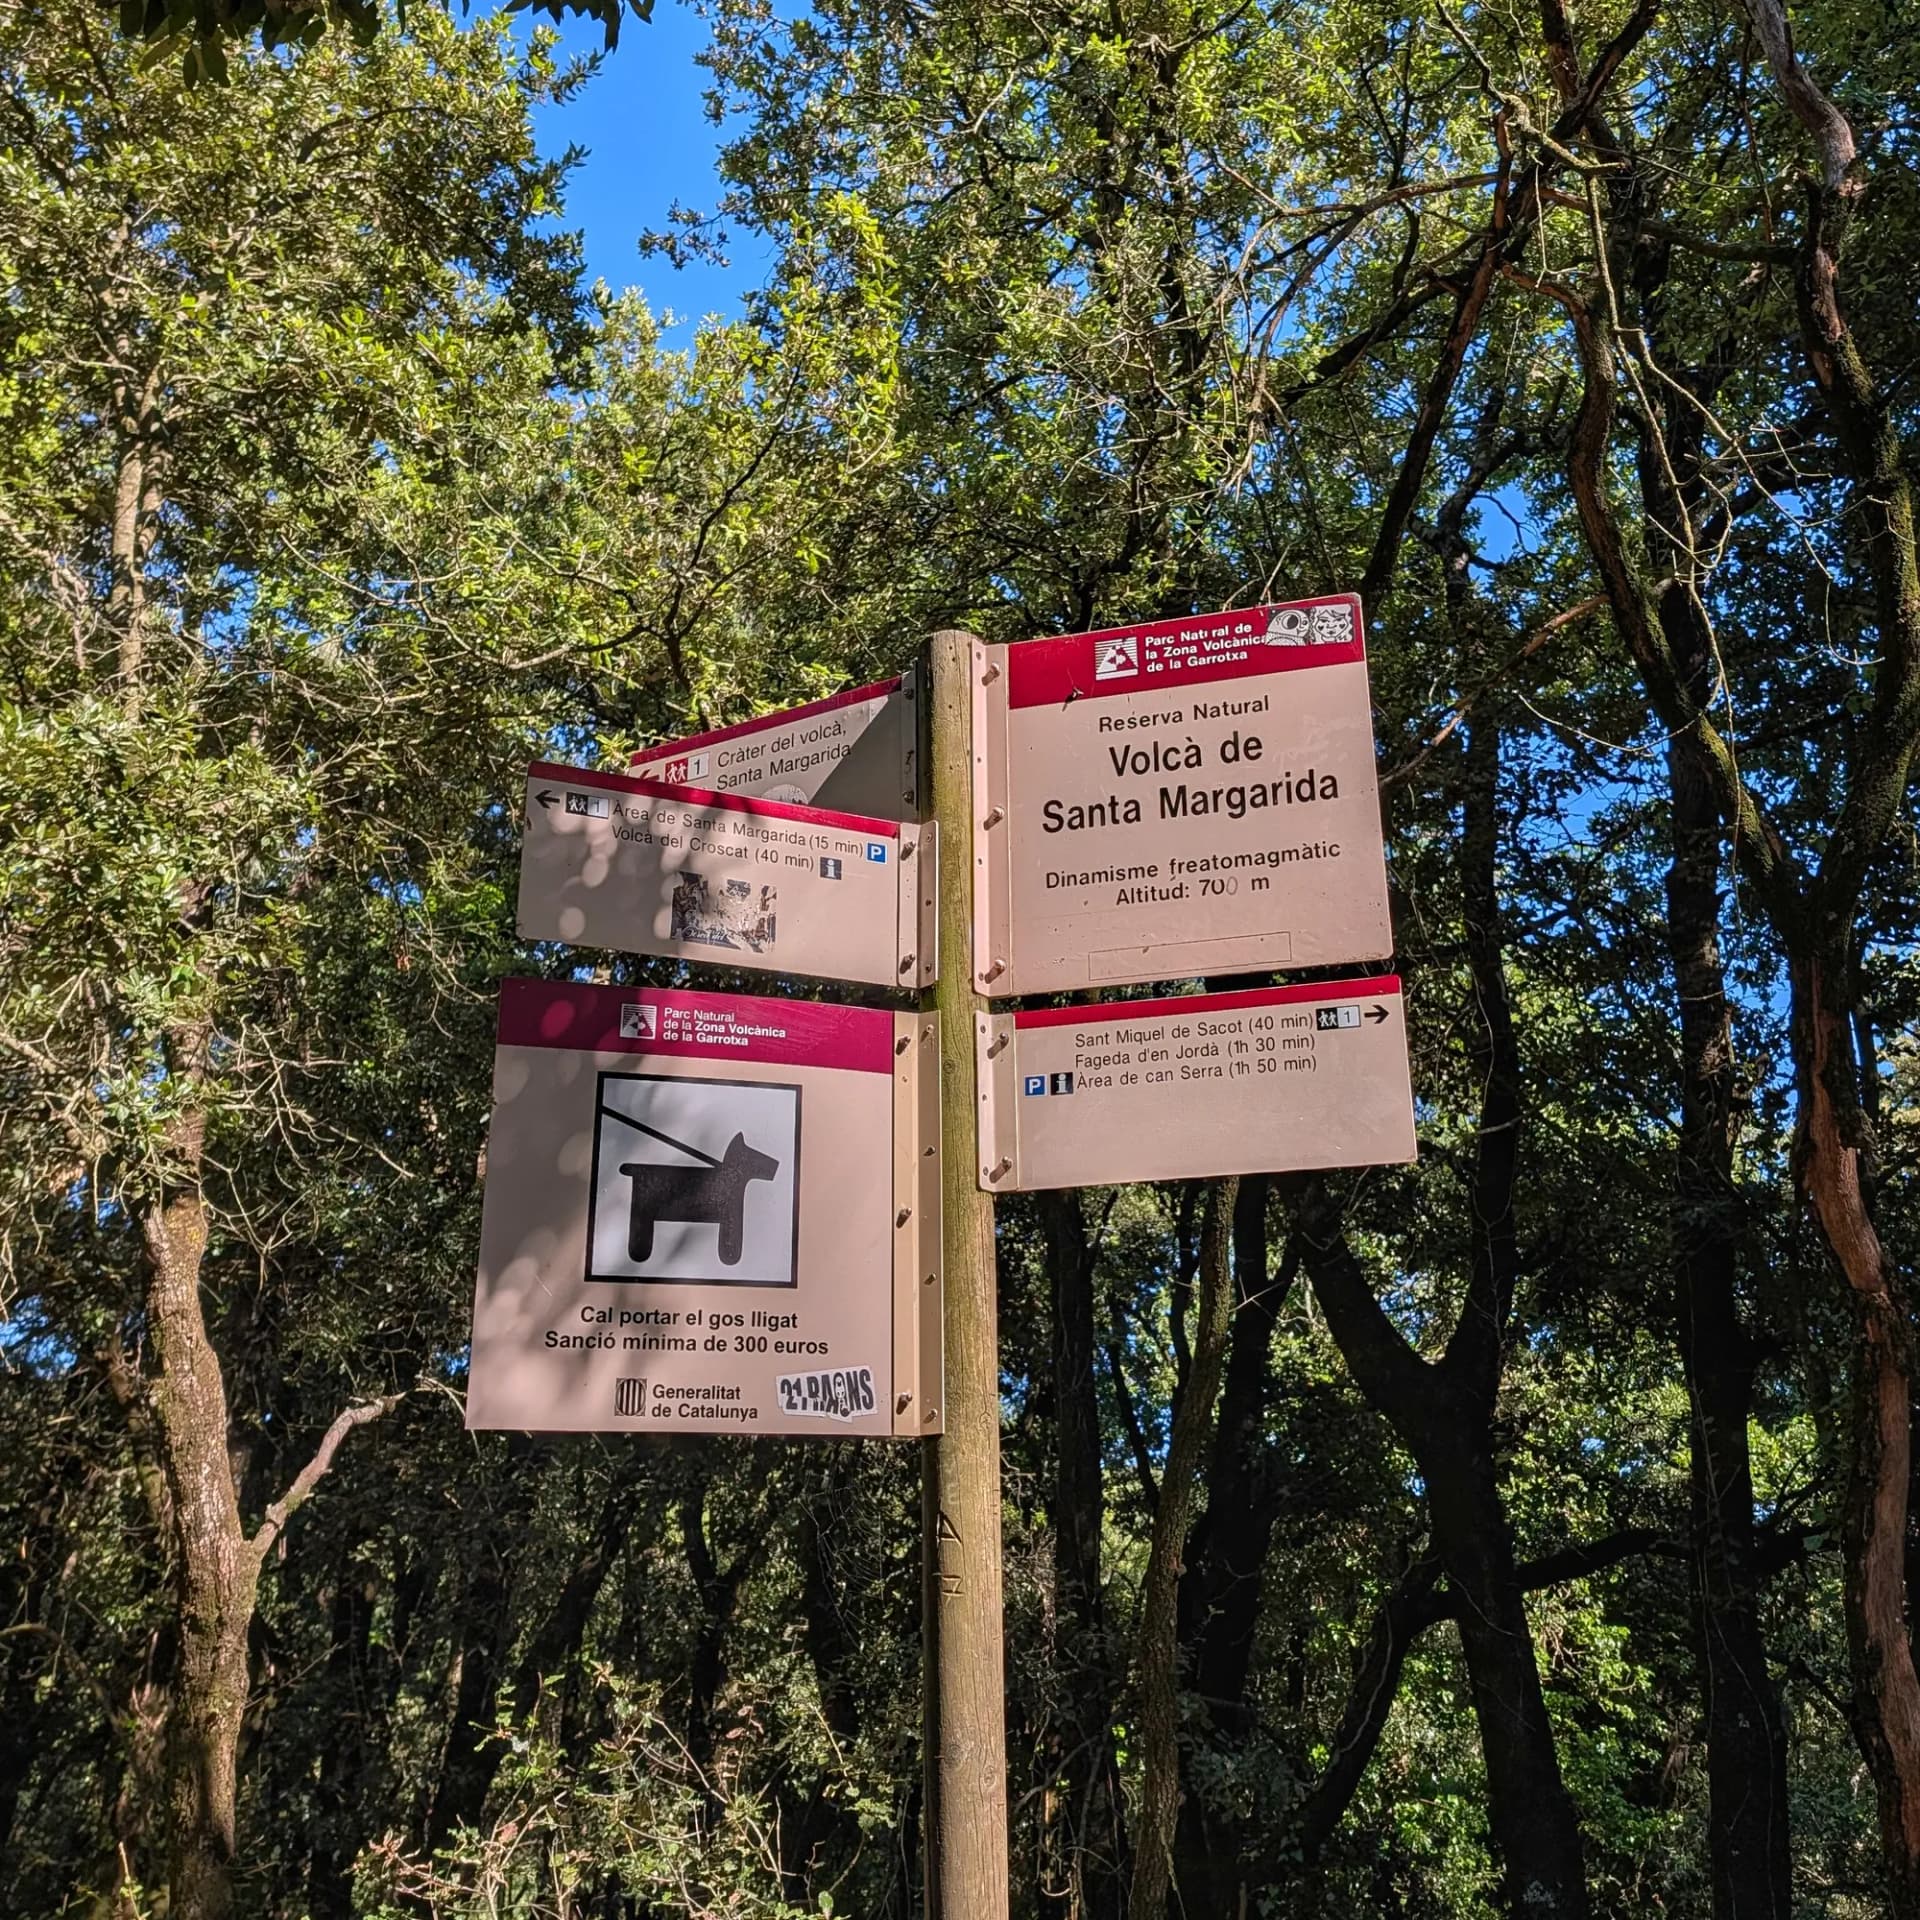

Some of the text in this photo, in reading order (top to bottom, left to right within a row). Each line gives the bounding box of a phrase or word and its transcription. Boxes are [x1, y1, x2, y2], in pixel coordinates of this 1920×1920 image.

[1145, 634, 1174, 647] Parc
[1234, 623, 1252, 634] de
[1146, 649, 1157, 660] la
[1163, 644, 1197, 658] Zona
[1147, 650, 1248, 673] de la Garrotxa
[1099, 695, 1269, 733] Reserva Natural
[717, 720, 847, 768] Cràter del volcà,
[1109, 731, 1263, 777] Volcà de
[693, 759, 701, 775] 1
[717, 743, 851, 791] Santa Margarida
[1042, 768, 1339, 834] Santa Margarida
[612, 824, 653, 844] Volcà
[660, 833, 683, 849] del
[689, 837, 748, 859] Croscat
[755, 848, 779, 864] (40
[785, 855, 814, 872] min)
[656, 810, 675, 825] de
[682, 813, 726, 833] Santa
[733, 822, 806, 847] Margarida
[809, 834, 829, 850] (15
[835, 840, 863, 858] min)
[1045, 840, 1341, 889] Dinamisme freatomagmàtic
[1116, 875, 1270, 906] Altitud: 700 m
[663, 1020, 786, 1038] de la Zona Volcànica
[664, 1007, 735, 1023] Parc Natural
[1343, 1010, 1350, 1024] 1
[663, 1031, 749, 1047] de la Garrotxa
[1075, 1012, 1313, 1048] Sant Miquel de Sacot (40 min)
[1075, 1033, 1315, 1070] Fageda d'en Jordà (1h 30 min)
[1077, 1072, 1113, 1089] Àrea
[1119, 1071, 1138, 1085] de
[1145, 1069, 1174, 1083] can
[1180, 1064, 1223, 1080] Serra
[1229, 1061, 1250, 1079] (1h
[1257, 1058, 1277, 1074] 50
[1284, 1055, 1317, 1072] min)
[581, 1306, 799, 1331] Cal portar el gos lligat
[544, 1331, 829, 1355] Sanció mínima de 300 euros
[652, 1383, 742, 1401] Generalitat
[651, 1402, 759, 1422] de Catalunya
